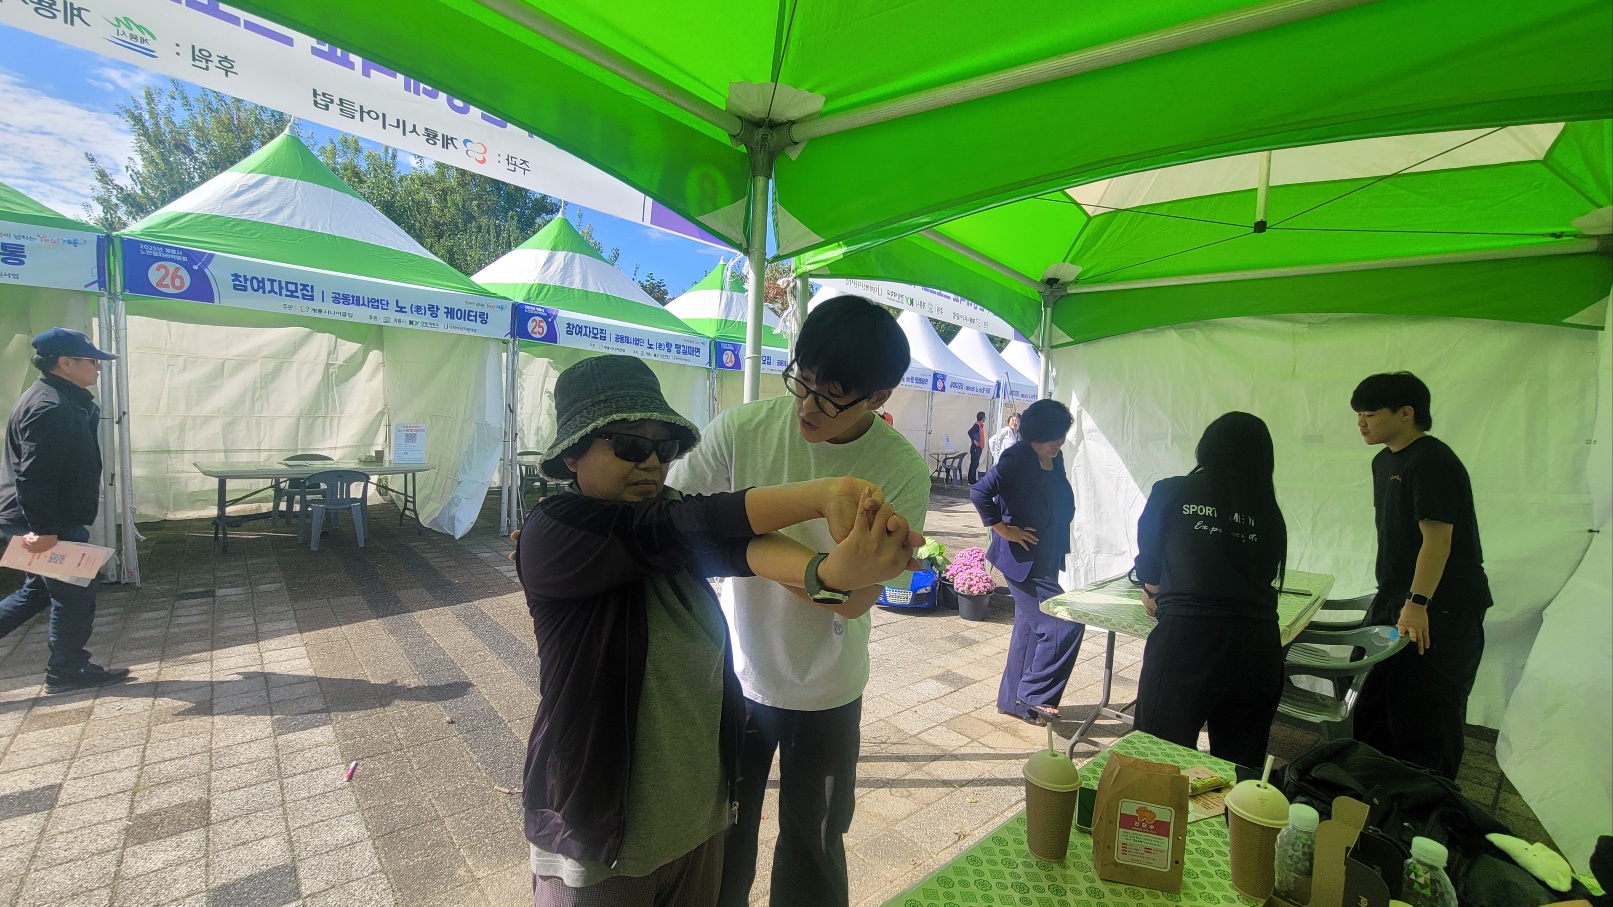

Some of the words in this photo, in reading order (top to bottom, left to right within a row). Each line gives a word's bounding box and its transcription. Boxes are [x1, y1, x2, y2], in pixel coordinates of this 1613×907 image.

[155, 264, 186, 291] 26
[231, 272, 315, 302] 참여자모집
[331, 291, 390, 311] 공동체사업단
[443, 305, 489, 325] 케이터링
[530, 318, 545, 336] 25
[565, 322, 607, 342] 참여자모집
